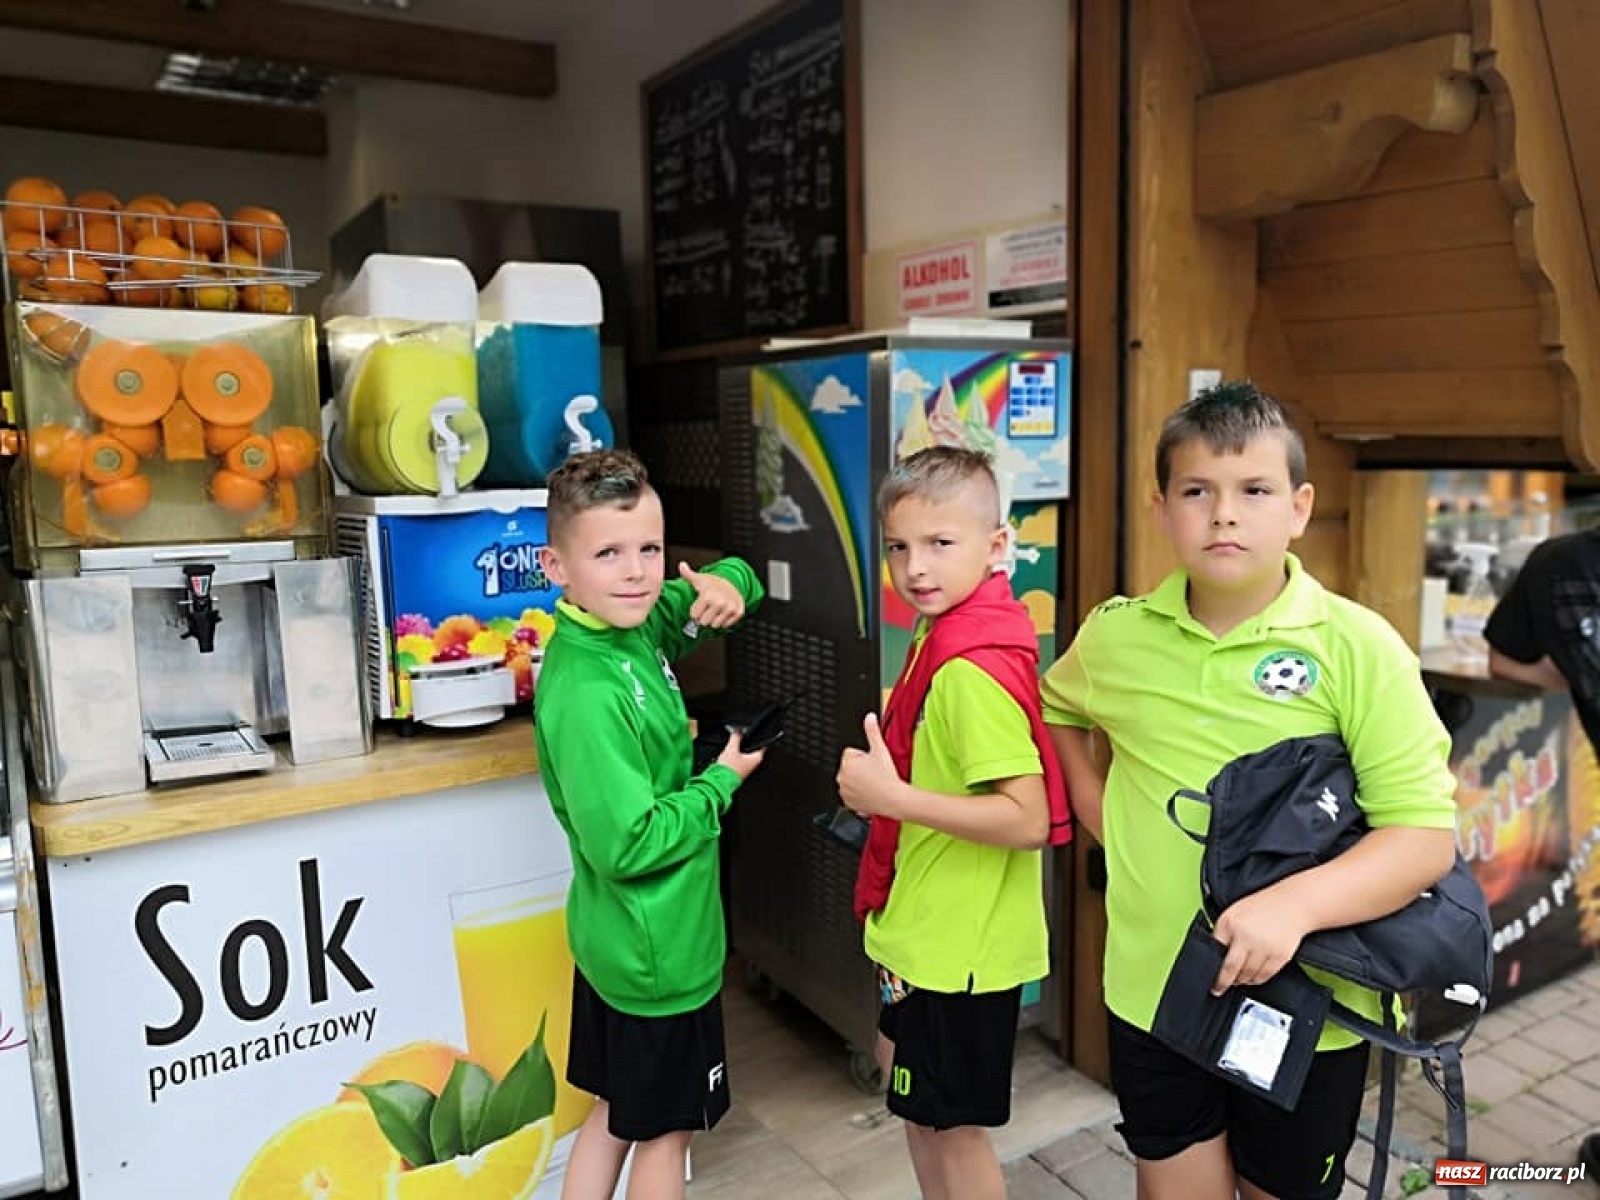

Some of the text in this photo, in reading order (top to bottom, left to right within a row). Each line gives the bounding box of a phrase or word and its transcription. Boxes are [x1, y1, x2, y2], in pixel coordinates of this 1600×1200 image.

[904, 254, 970, 289] ALKOHOL
[134, 857, 375, 1046] Sok
[149, 1007, 377, 1103] pomarańczowy
[893, 1064, 911, 1096] 10
